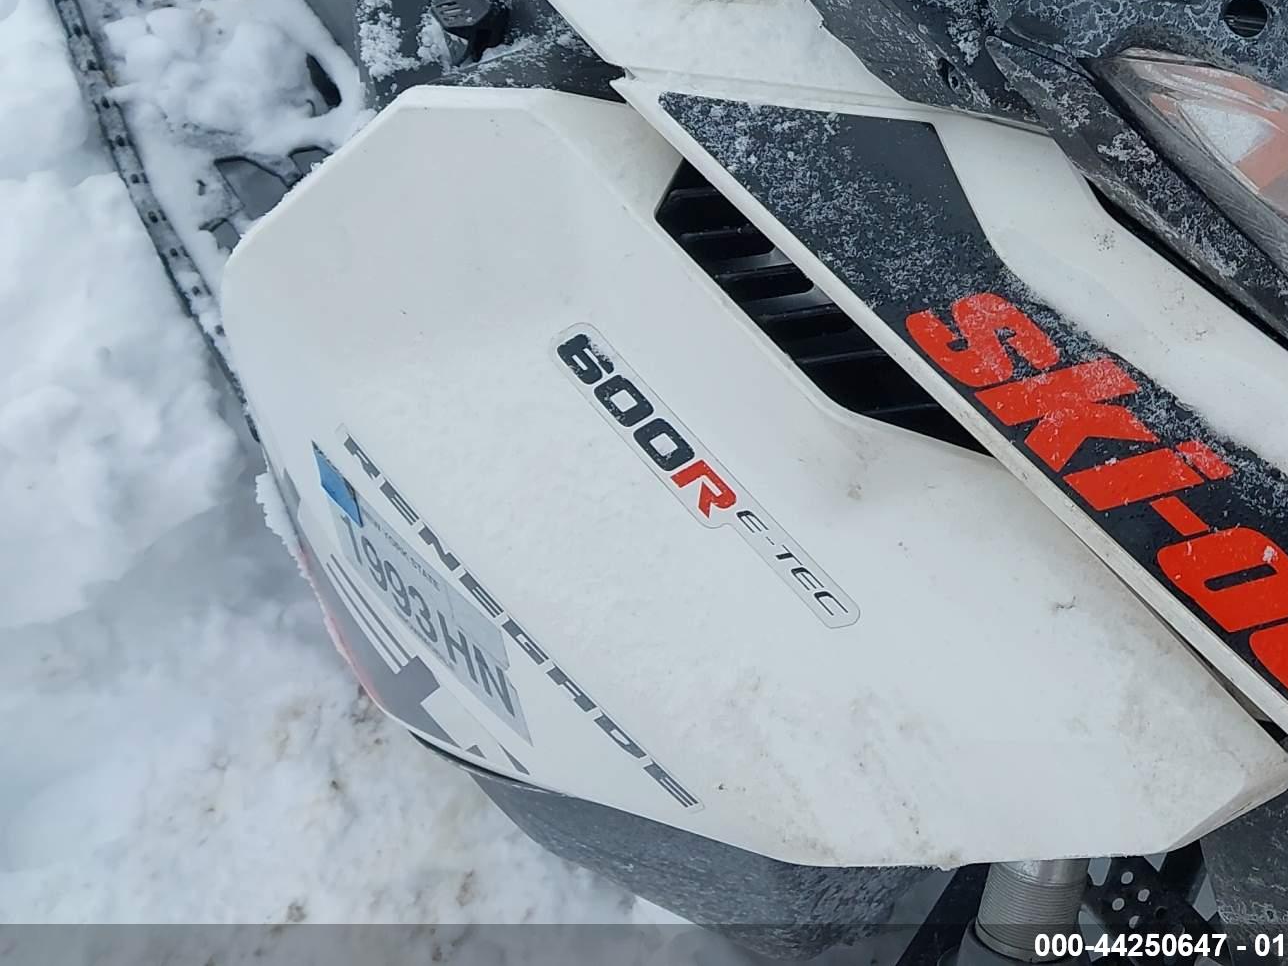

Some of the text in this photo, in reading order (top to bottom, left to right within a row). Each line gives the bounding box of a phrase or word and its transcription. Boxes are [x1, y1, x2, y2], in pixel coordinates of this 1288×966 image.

[343, 433, 699, 808] RENEGADE
[556, 333, 849, 617] 600R E-TEC
